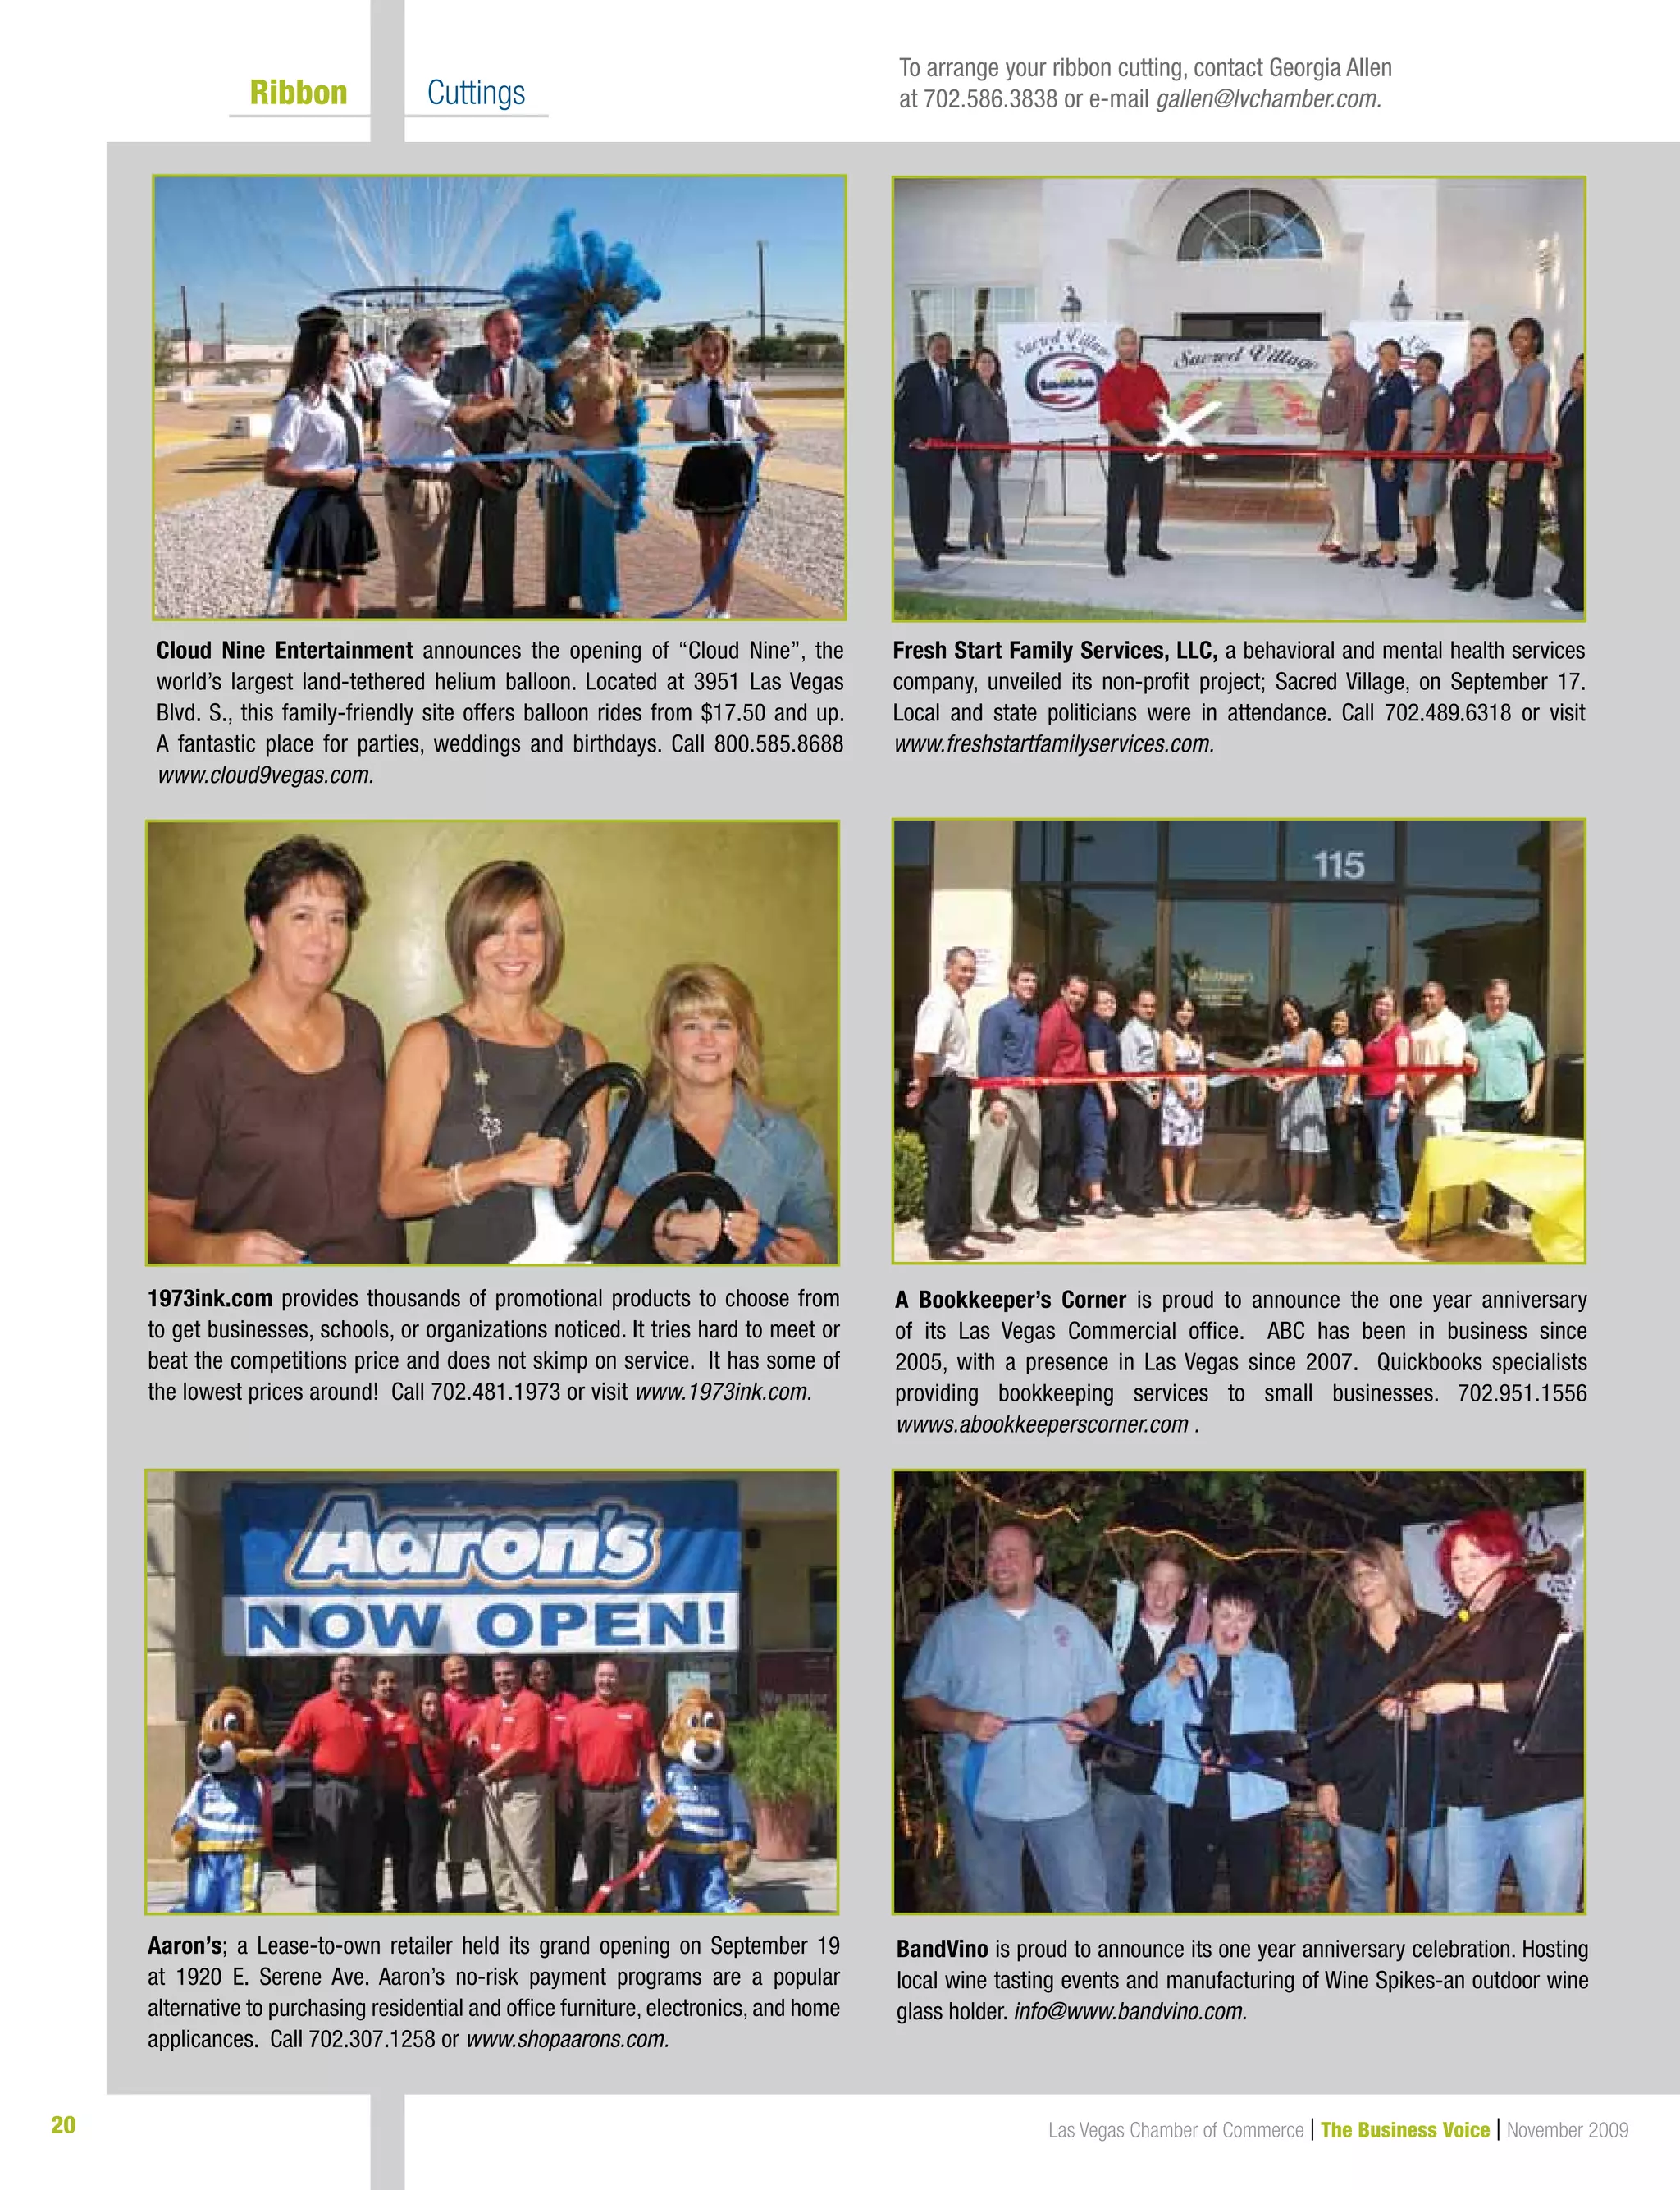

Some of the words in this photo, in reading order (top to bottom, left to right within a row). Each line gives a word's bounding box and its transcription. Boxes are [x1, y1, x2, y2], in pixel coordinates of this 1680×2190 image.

[899, 57, 920, 77] To
[926, 62, 999, 82] arrange
[1005, 62, 1048, 81] your
[1053, 57, 1112, 77] ribbon
[1118, 57, 1188, 82] cutting,
[1194, 57, 1264, 77] contact
[1270, 57, 1342, 82] Georgia
[1345, 57, 1392, 77] Allen
[250, 78, 348, 106] Ribbon
[427, 78, 526, 112] Cuttings
[899, 89, 919, 108] at
[924, 89, 1058, 108] 702.586.3838
[1064, 92, 1084, 108] or
[1089, 88, 1149, 108] e-mail
[1156, 88, 1381, 112] gallen@lvchamber.com.
[157, 640, 212, 660] Cloud
[222, 640, 266, 660] Nine
[276, 640, 414, 660] Entertainment
[422, 644, 522, 660] announces
[531, 640, 560, 660] the
[569, 640, 641, 664] opening
[651, 640, 670, 660] of
[679, 640, 739, 660] “Cloud
[750, 640, 806, 663] Nine”,
[815, 640, 844, 660] the
[893, 640, 947, 660] Fresh
[954, 640, 1002, 660] Start
[1010, 640, 1074, 664] Family
[1080, 640, 1170, 663] Services,
[1176, 640, 1218, 663] LLC,
[1226, 644, 1237, 660] a
[1244, 640, 1335, 660] behavioral
[1342, 640, 1375, 660] and
[1382, 640, 1443, 660] mental
[1450, 640, 1504, 660] health
[1512, 640, 1586, 660] services
[156, 671, 222, 691] world’s
[231, 671, 294, 695] largest
[303, 671, 425, 691] land-tethered
[435, 671, 495, 691] helium
[506, 671, 577, 691] balloon.
[586, 671, 657, 691] Located
[667, 672, 685, 691] at
[693, 671, 737, 691] 3951
[751, 671, 782, 691] Las
[789, 671, 844, 695] Vegas
[892, 675, 978, 695] company,
[988, 671, 1061, 691] unveiled
[1072, 671, 1093, 691] its
[1102, 671, 1190, 695] non-profit
[1199, 671, 1265, 695] project;
[1276, 671, 1337, 691] Sacred
[1345, 671, 1410, 695] Village,
[1419, 675, 1440, 691] on
[1450, 671, 1549, 695] September
[1558, 671, 1586, 691] 17.
[895, 734, 1214, 757] www.freshstartfamilyservices.com.
[158, 765, 373, 789] www.cloud9vegas.com.
[1314, 850, 1365, 880] 115
[148, 1288, 273, 1308] 1973ink.com
[282, 1288, 358, 1311] provides
[366, 1288, 461, 1308] thousands
[469, 1288, 487, 1308] of
[495, 1288, 602, 1311] promotional
[612, 1288, 691, 1312] products
[698, 1289, 717, 1308] to
[725, 1288, 790, 1308] choose
[797, 1288, 840, 1308] from
[894, 1290, 910, 1309] A
[919, 1290, 1052, 1313] Bookkeeper’s
[1061, 1289, 1127, 1309] Corner
[1137, 1290, 1152, 1309] is
[1162, 1290, 1214, 1313] proud
[1223, 1290, 1242, 1309] to
[1252, 1293, 1340, 1309] announce
[1349, 1290, 1379, 1309] the
[1389, 1293, 1422, 1309] one
[1432, 1293, 1472, 1313] year
[1481, 1290, 1588, 1313] anniversary
[147, 1382, 176, 1401] the
[183, 1382, 243, 1401] lowest
[249, 1382, 304, 1405] prices
[309, 1382, 378, 1401] around!
[391, 1381, 424, 1401] Call
[431, 1382, 561, 1401] 702.481.1973
[567, 1386, 586, 1401] or
[591, 1382, 628, 1401] visit
[636, 1382, 811, 1401] www.1973ink.com.
[897, 1414, 1189, 1438] wwws.abookkeeperscorner.com
[247, 1603, 443, 1648] NOW
[477, 1602, 726, 1648] OPEN!
[147, 1936, 227, 1958] Aaron’s;
[237, 1940, 249, 1955] a
[258, 1936, 381, 1955] Lease-to-own
[390, 1936, 454, 1955] retailer
[462, 1936, 500, 1955] held
[509, 1936, 531, 1955] its
[539, 1936, 590, 1959] grand
[600, 1936, 670, 1959] opening
[679, 1940, 701, 1955] on
[710, 1936, 809, 1959] September
[818, 1936, 840, 1955] 19
[897, 1939, 988, 1959] BandVino
[996, 1939, 1011, 1959] is
[1017, 1939, 1067, 1963] proud
[1073, 1940, 1091, 1959] to
[1098, 1943, 1185, 1959] announce
[1191, 1939, 1212, 1959] its
[1218, 1943, 1251, 1959] one
[1257, 1943, 1297, 1962] year
[1302, 1939, 1406, 1963] anniversary
[1412, 1939, 1516, 1959] celebration.
[1522, 1939, 1589, 1963] Hosting
[897, 1970, 938, 1990] local
[944, 1970, 988, 1990] wine
[993, 1970, 1054, 1994] tasting
[1061, 1970, 1120, 1990] events
[1125, 1970, 1159, 1990] and
[1166, 1970, 1294, 1994] manufacturing
[1302, 1970, 1320, 1990] of
[1324, 1970, 1369, 1990] Wine
[1376, 1970, 1465, 1994] Spikes-an
[1472, 1970, 1541, 1990] outdoor
[1546, 1970, 1589, 1990] wine
[897, 2001, 943, 2025] glass
[949, 2001, 1008, 2021] holder.
[1014, 2000, 1247, 2021] info@www.bandvino.com.
[148, 2028, 258, 2052] applicances.
[270, 2028, 303, 2048] Call
[308, 2029, 436, 2048] 702.307.1258
[441, 2032, 460, 2048] or
[467, 2029, 669, 2052] www.shopaarons.com.
[51, 2115, 76, 2134] 20
[1049, 2121, 1075, 2138] Las
[1079, 2121, 1125, 2142] Vegas
[1130, 2121, 1198, 2138] Chamber
[1203, 2121, 1218, 2138] of
[1223, 2121, 1304, 2138] Commerce
[1320, 2121, 1353, 2139] The
[1358, 2121, 1438, 2139] Business
[1442, 2121, 1491, 2139] Voice
[1508, 2121, 1584, 2138] November
[1589, 2121, 1629, 2138] 2009
